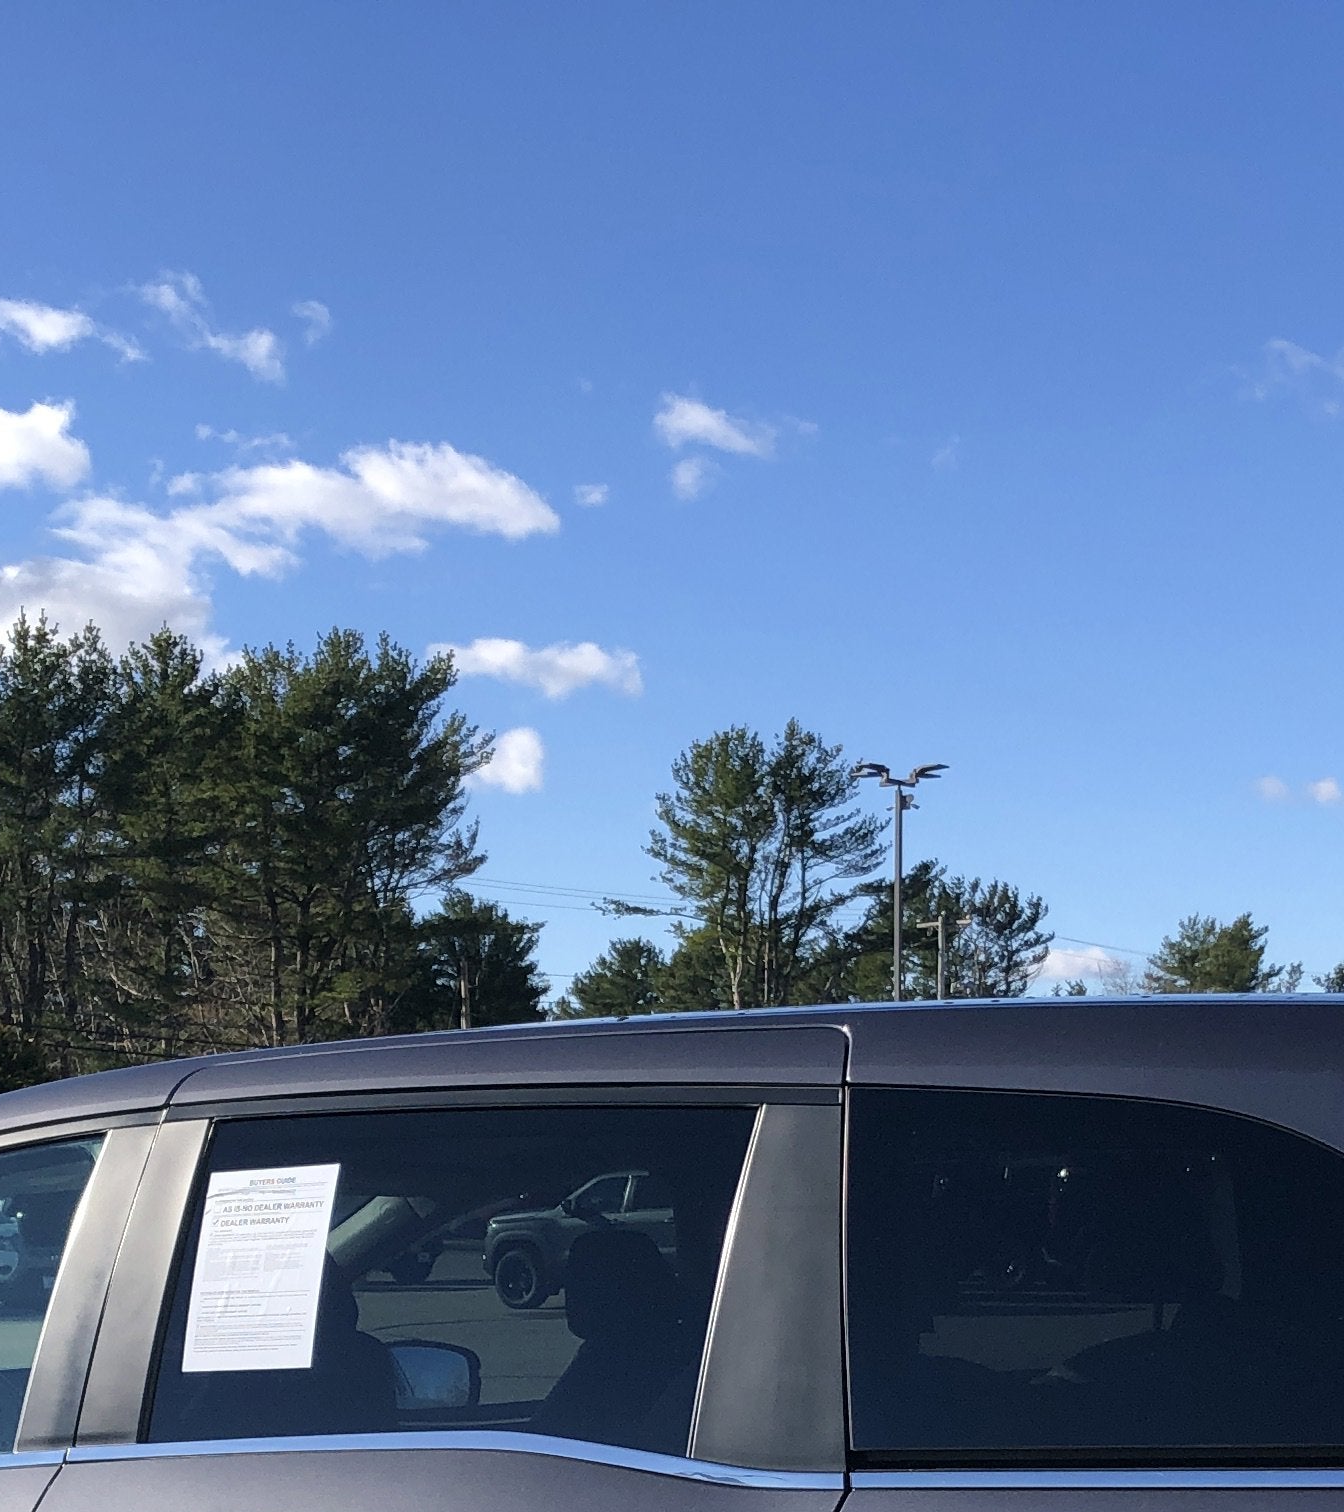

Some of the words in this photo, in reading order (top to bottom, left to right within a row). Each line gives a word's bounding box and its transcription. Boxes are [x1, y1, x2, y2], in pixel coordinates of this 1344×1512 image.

[254, 1202, 283, 1211] DEALER
[284, 1200, 325, 1210] WARRANTY
[220, 1219, 249, 1228] DEALER
[250, 1216, 290, 1226] WARRANTY
